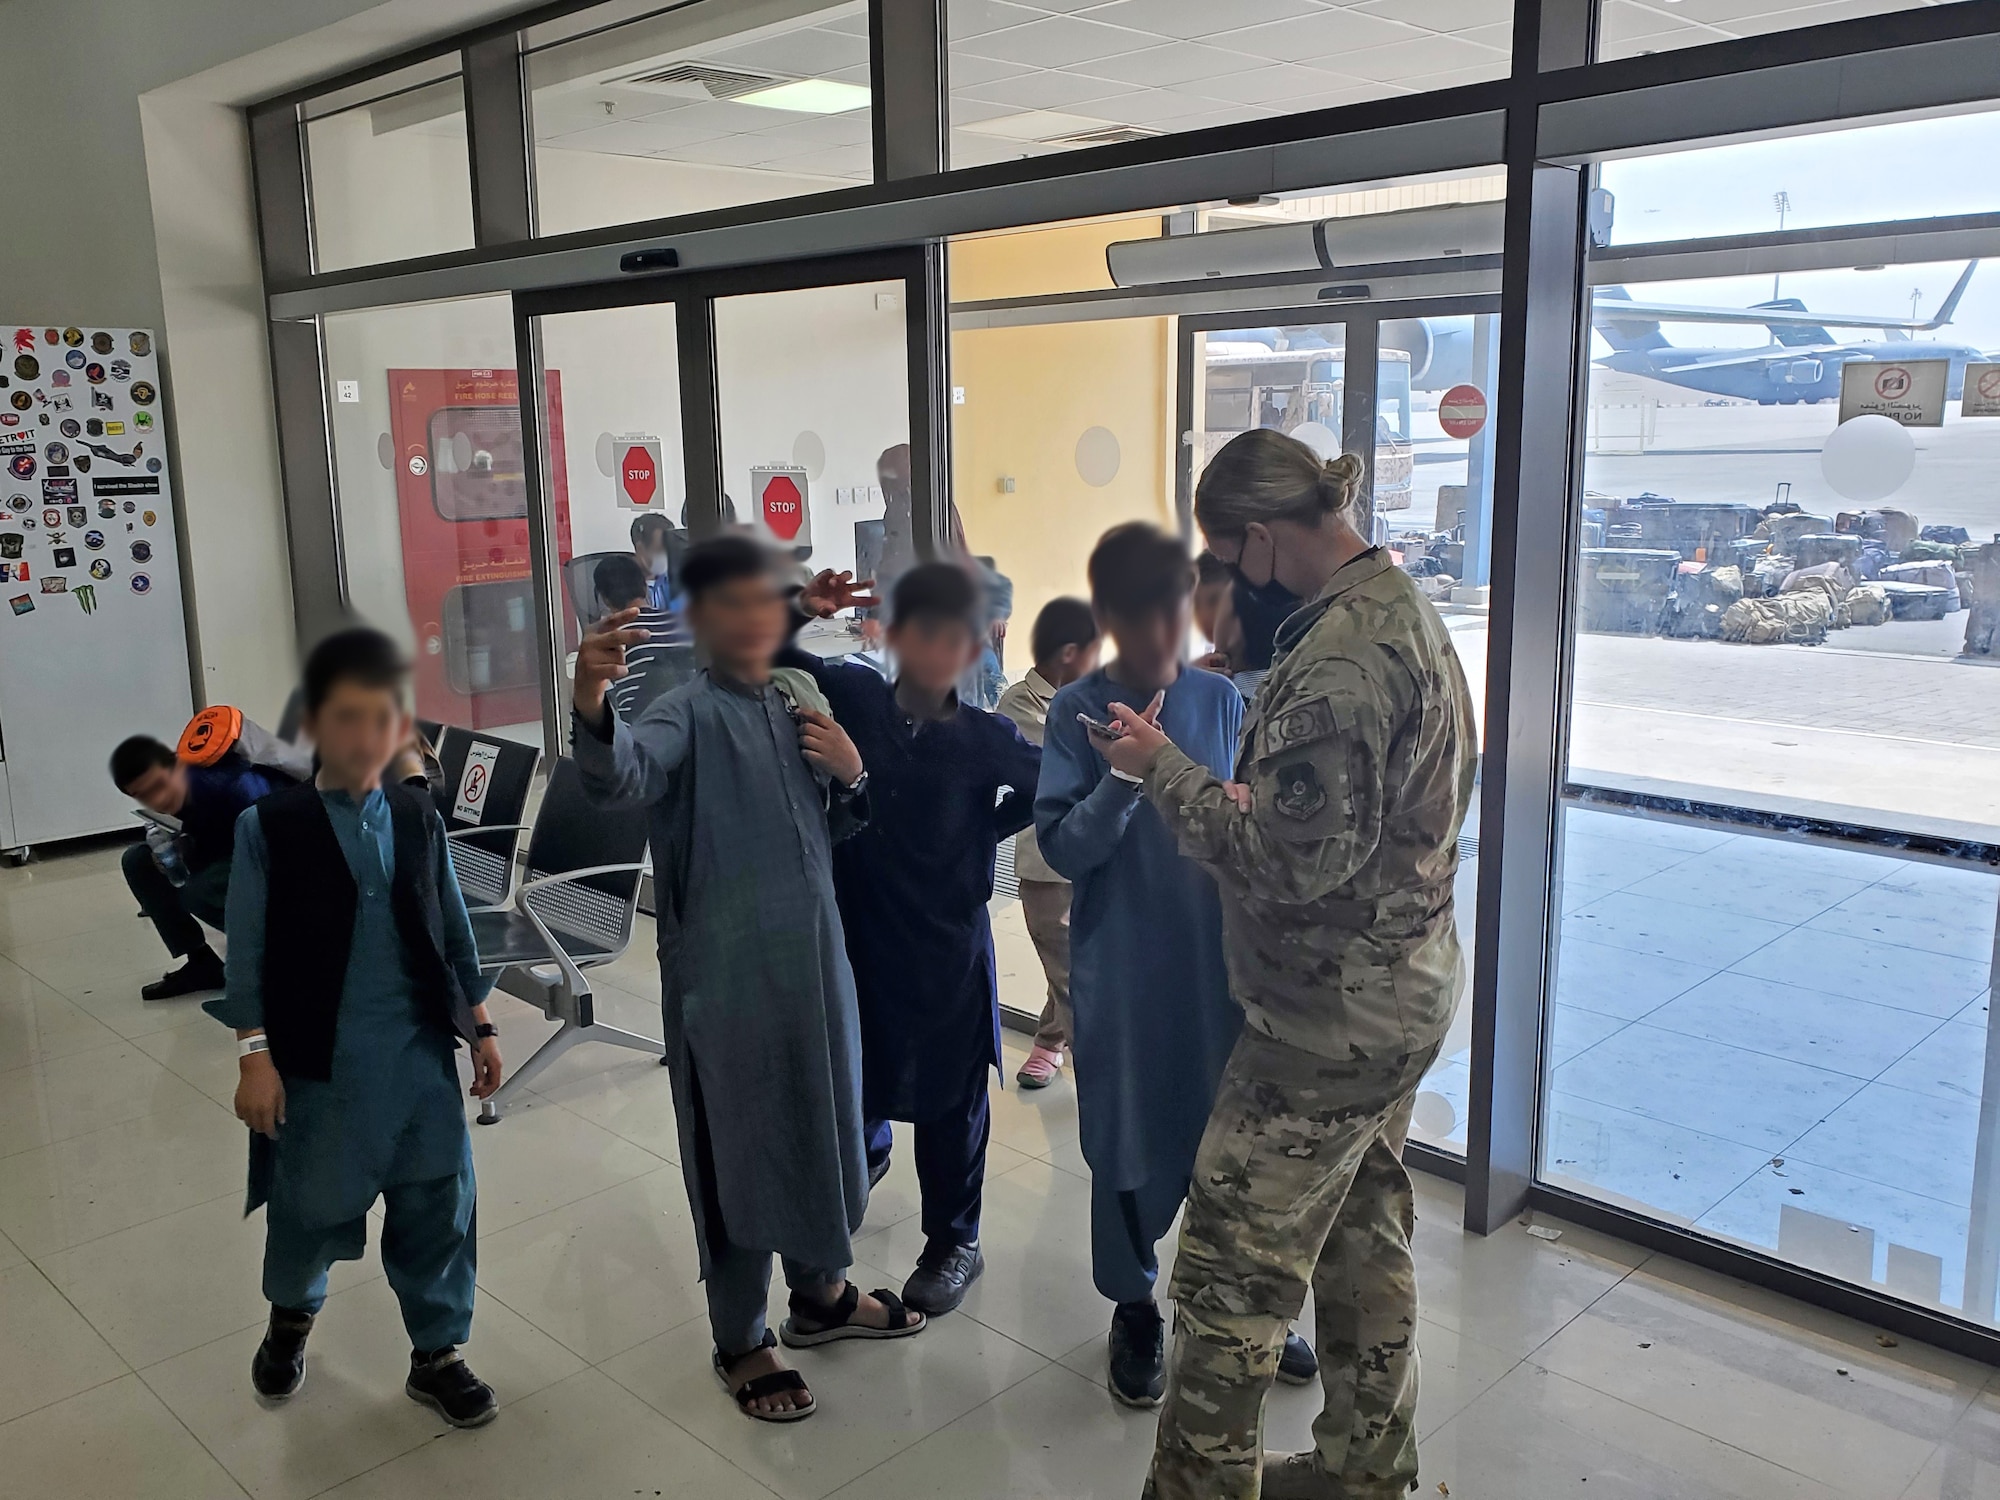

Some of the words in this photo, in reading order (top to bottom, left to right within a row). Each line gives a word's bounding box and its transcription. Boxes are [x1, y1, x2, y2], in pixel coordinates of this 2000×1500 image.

[474, 392, 497, 400] HOSE
[498, 392, 517, 400] REEL
[629, 470, 650, 480] STOP
[769, 501, 796, 514] STOP
[456, 575, 473, 583] FIRE
[464, 806, 480, 817] SITTING
